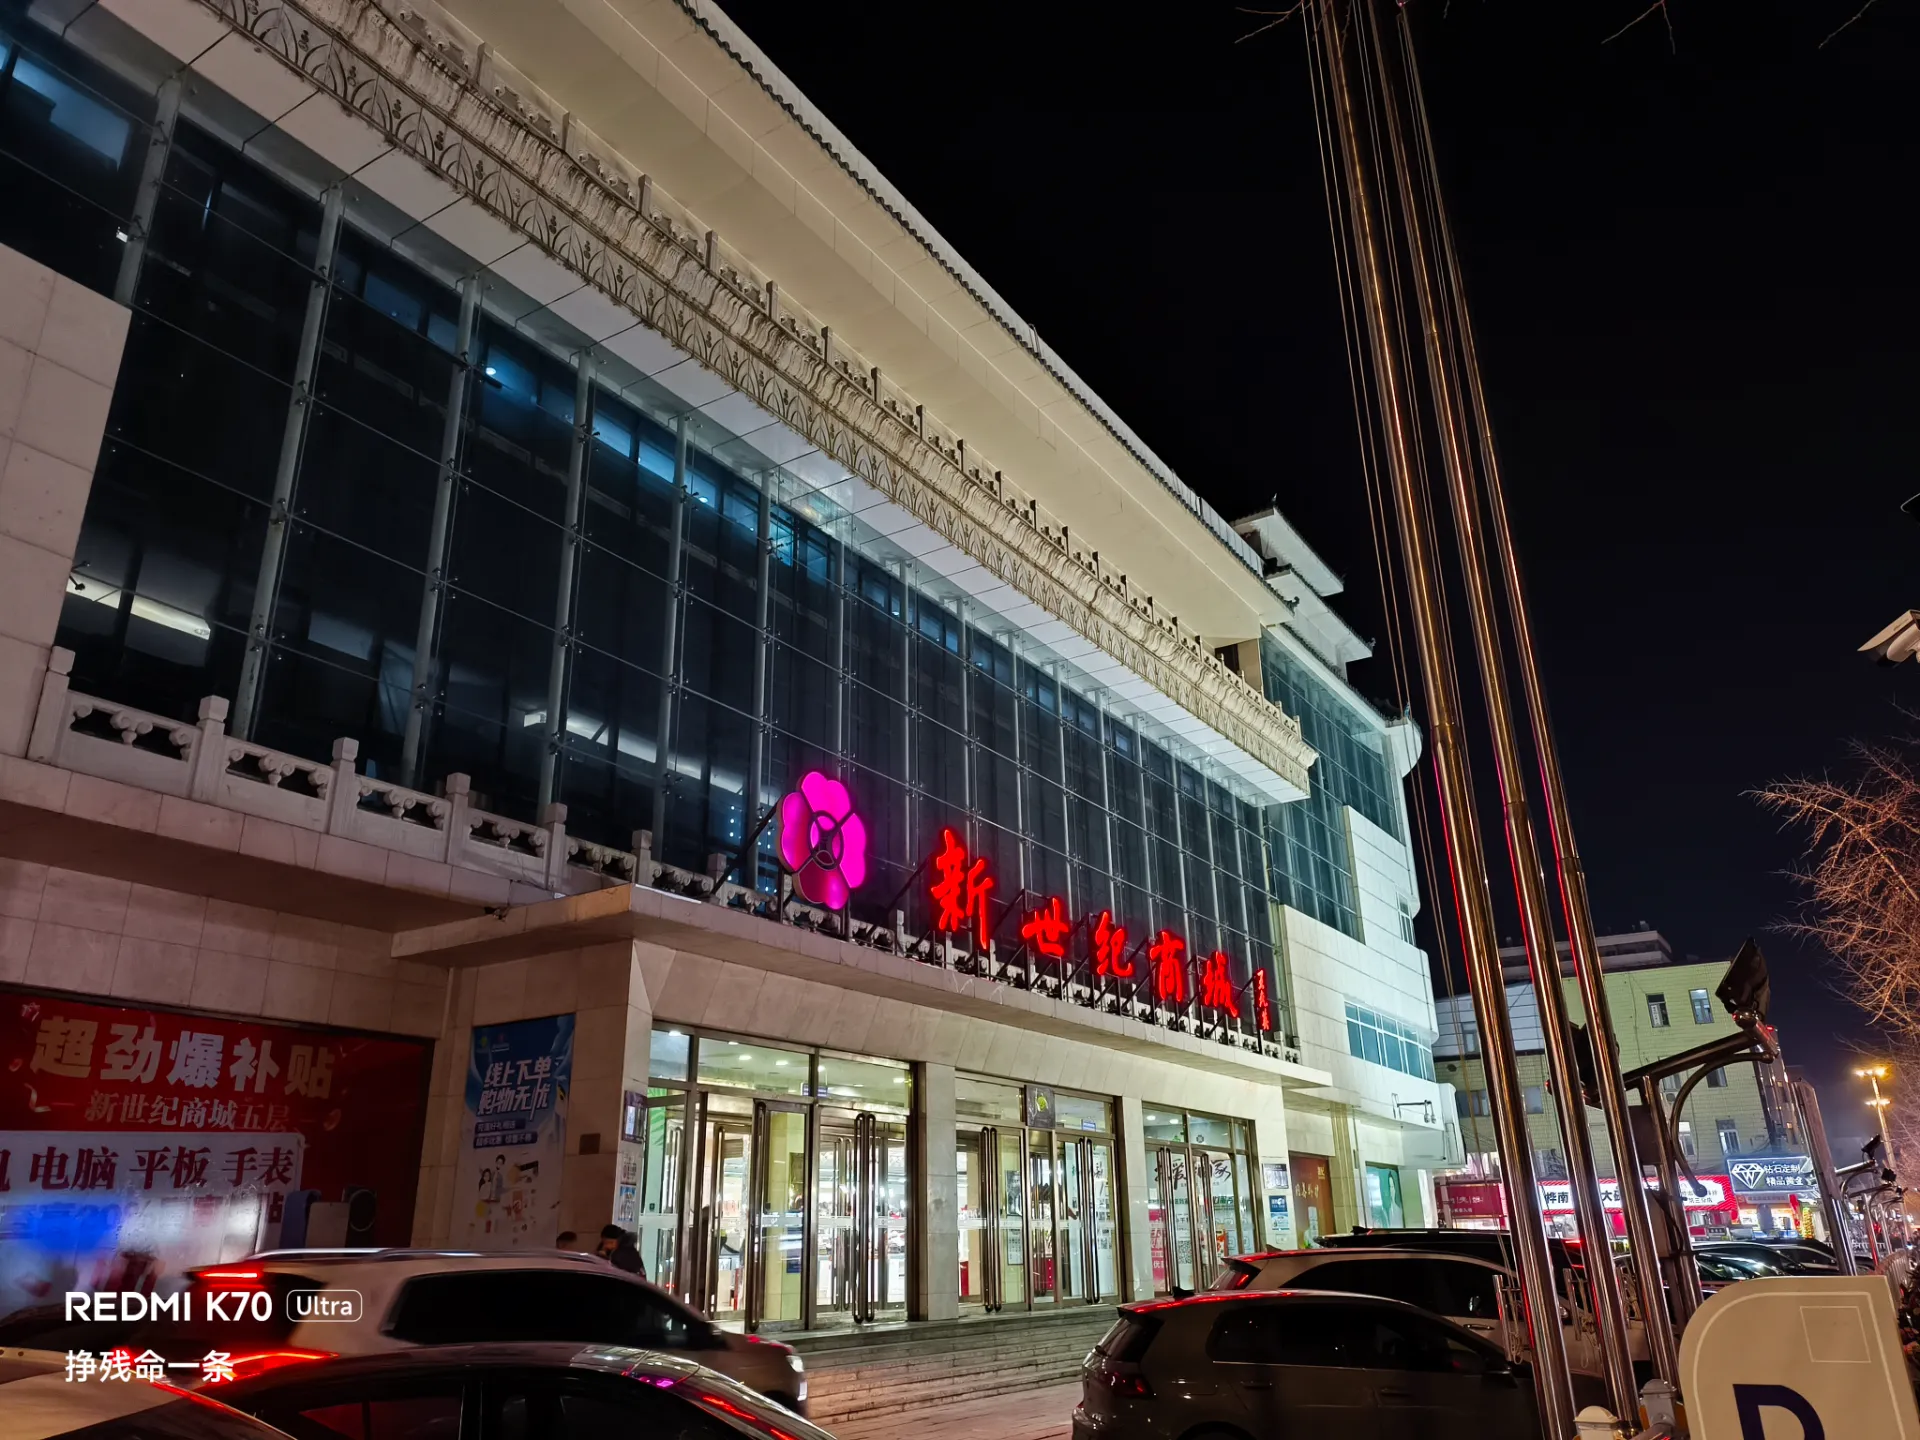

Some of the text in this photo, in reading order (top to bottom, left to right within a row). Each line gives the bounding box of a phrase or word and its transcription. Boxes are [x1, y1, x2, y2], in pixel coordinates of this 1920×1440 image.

[930, 828, 1239, 1018] 新世纪商城
[30, 1016, 335, 1099] 超劲爆补贴
[482, 1056, 553, 1090] 线上下单
[84, 1089, 290, 1133] 新世纪商城五层
[477, 1083, 551, 1117] 购物无忧
[29, 1146, 119, 1190] 电脑
[129, 1146, 210, 1189] 平板
[222, 1146, 294, 1187] 手表
[1764, 1164, 1801, 1174] 钻石定制
[1766, 1176, 1804, 1186] 精品黄金
